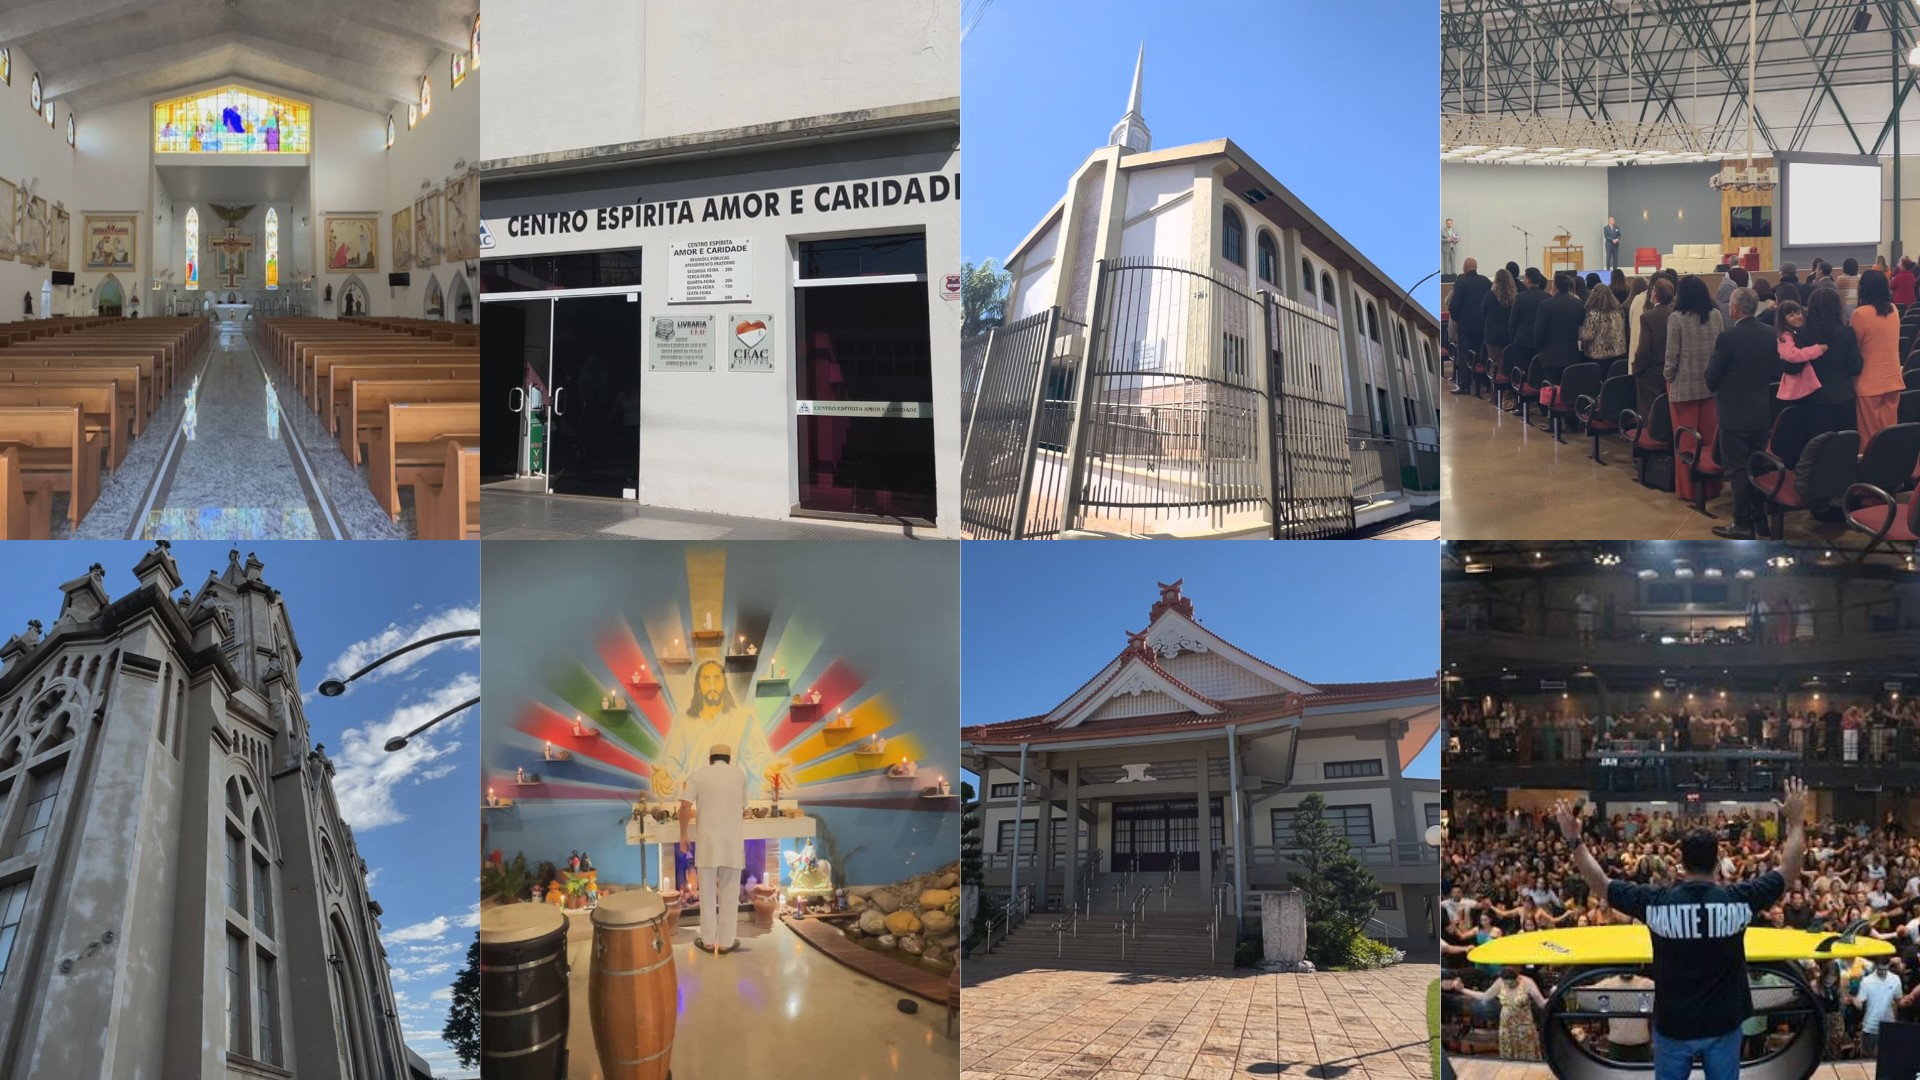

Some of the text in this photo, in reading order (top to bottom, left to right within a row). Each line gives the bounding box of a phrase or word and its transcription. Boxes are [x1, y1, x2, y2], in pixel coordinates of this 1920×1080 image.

[508, 210, 588, 237] CENTRO
[596, 197, 695, 230] ESPÍRITA
[702, 192, 780, 222] AMOR
[791, 189, 803, 214] E
[674, 248, 697, 256] AMOR
[706, 245, 747, 254] CARIDADE
[678, 320, 707, 328] LIVRARIA
[734, 349, 769, 359] CEAC
